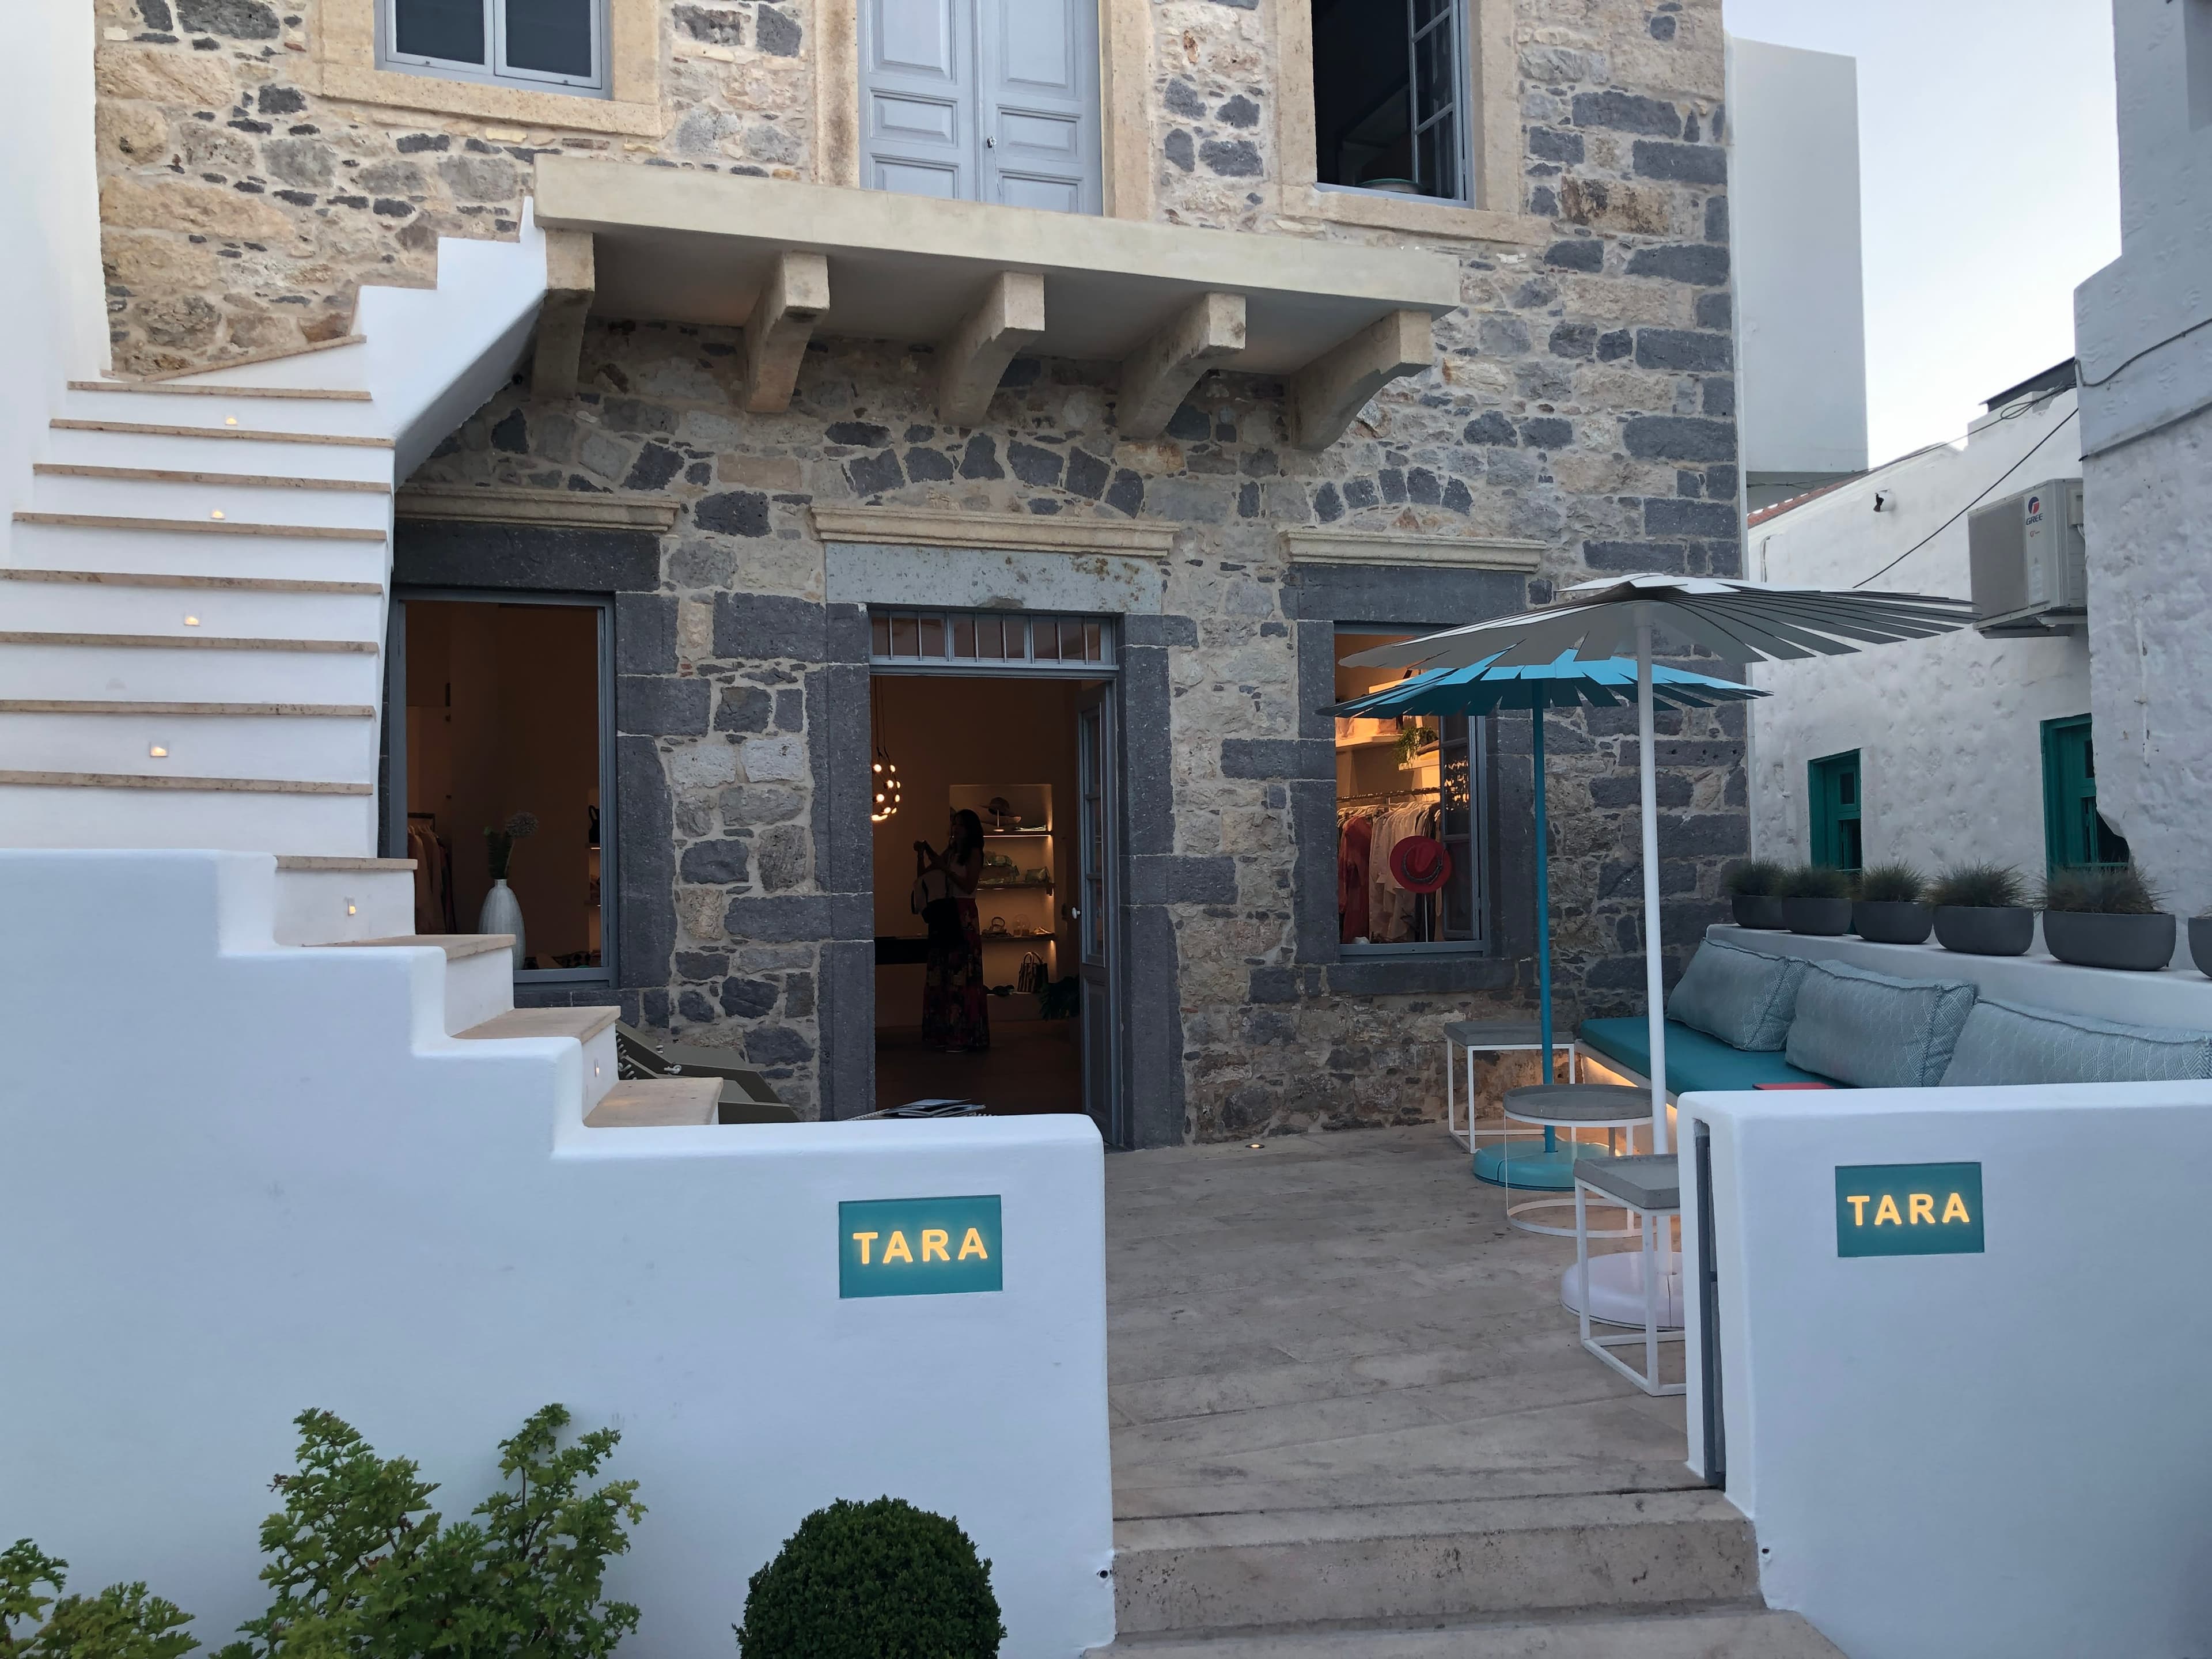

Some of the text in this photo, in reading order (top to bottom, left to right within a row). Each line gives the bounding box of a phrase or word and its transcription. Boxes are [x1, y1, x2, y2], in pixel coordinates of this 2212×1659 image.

[2026, 513, 2043, 525] GREE
[1847, 1192, 1970, 1226] TARA
[853, 1228, 988, 1264] TARA
